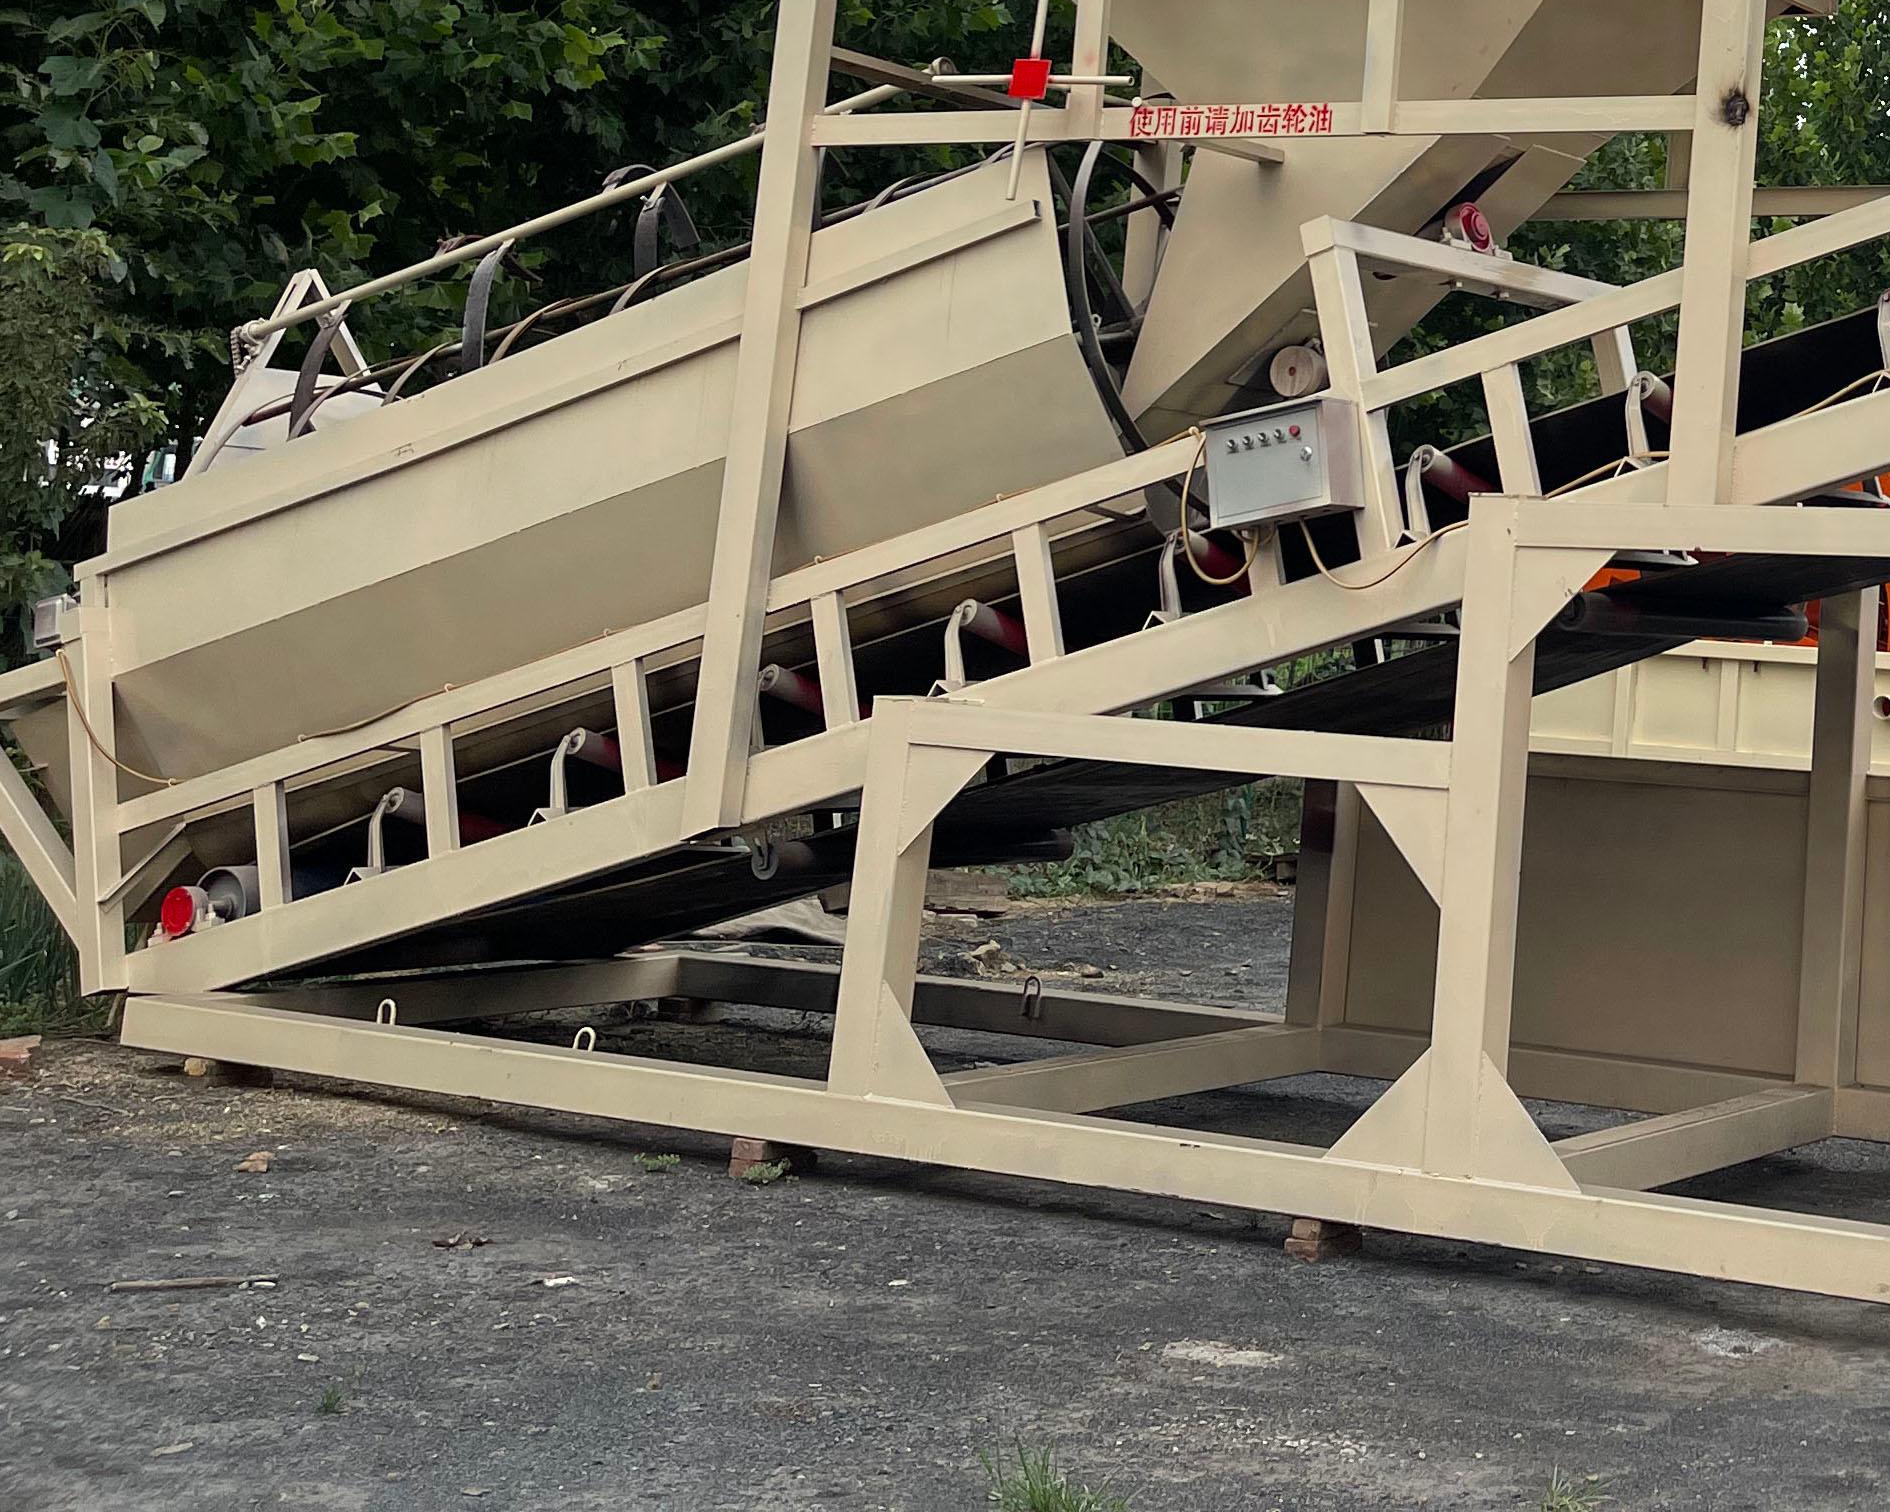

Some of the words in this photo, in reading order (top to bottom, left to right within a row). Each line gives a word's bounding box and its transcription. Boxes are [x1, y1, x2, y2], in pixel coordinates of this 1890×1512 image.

[1129, 103, 1333, 138] 使用前请加齿轮油
